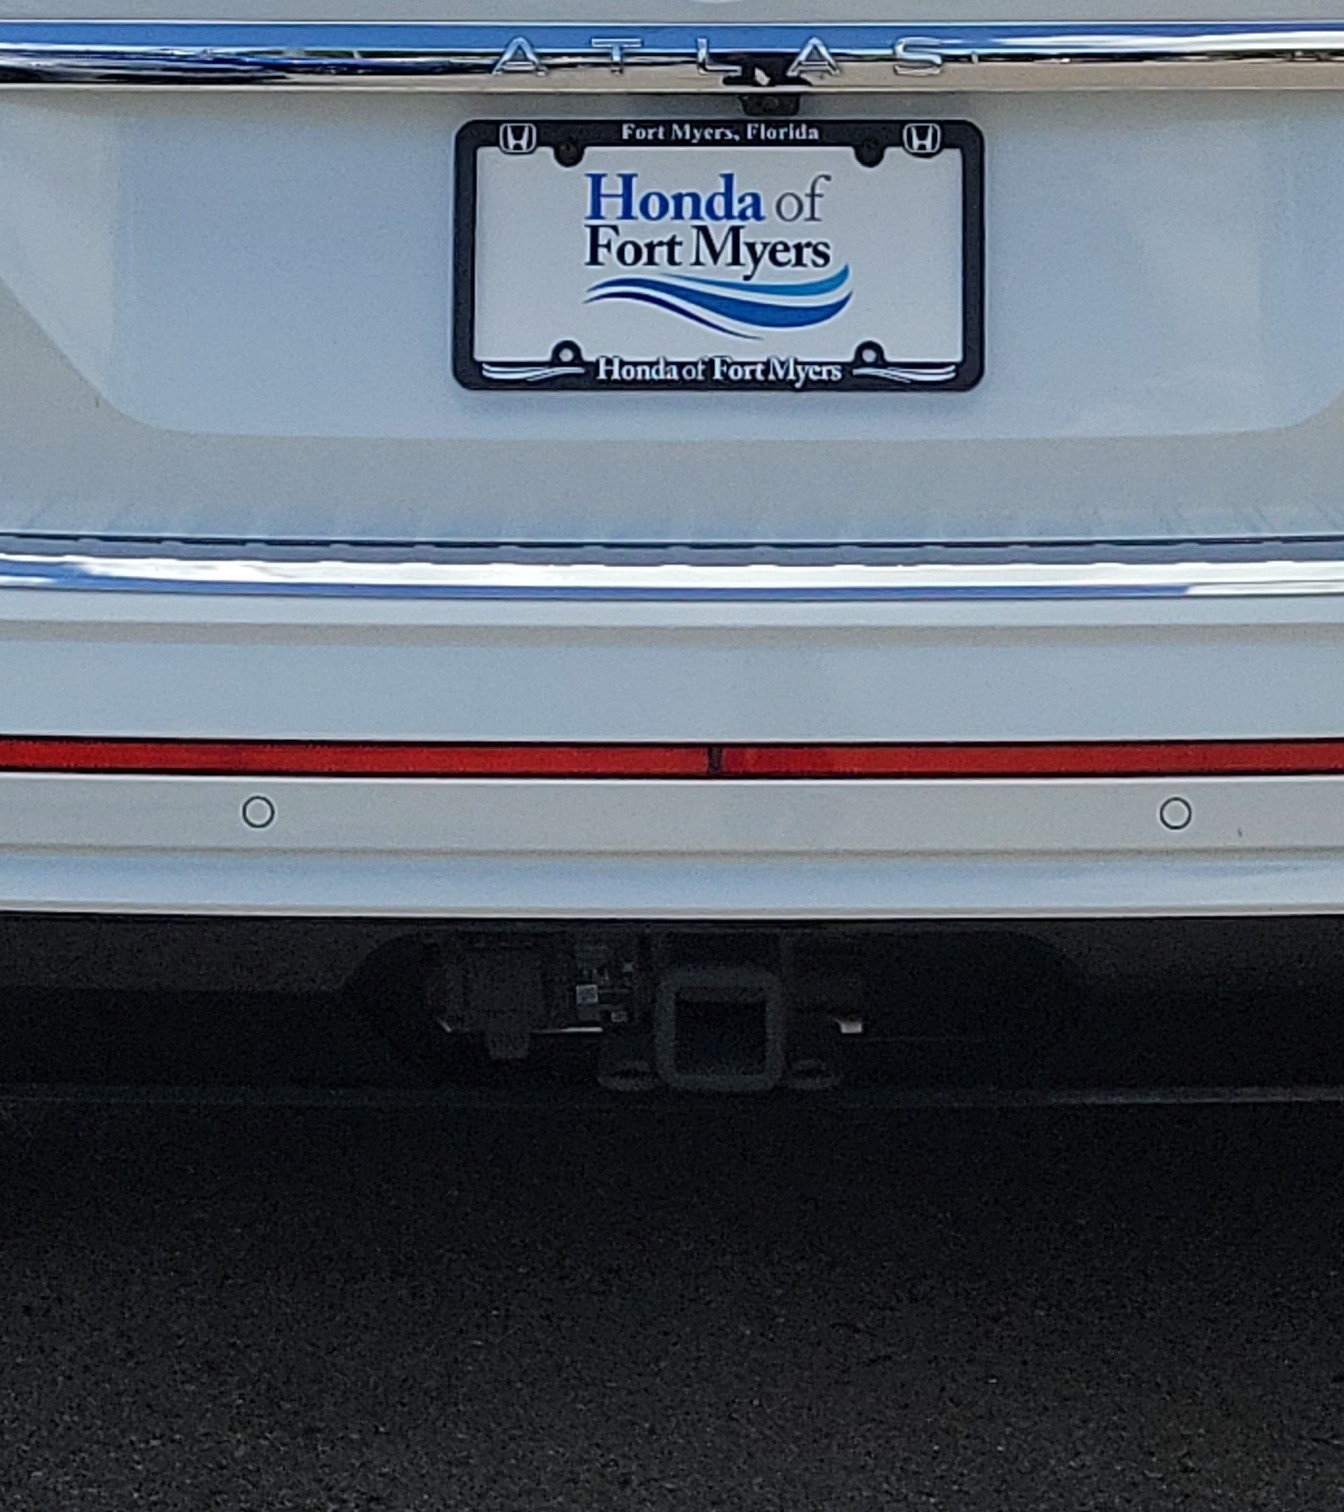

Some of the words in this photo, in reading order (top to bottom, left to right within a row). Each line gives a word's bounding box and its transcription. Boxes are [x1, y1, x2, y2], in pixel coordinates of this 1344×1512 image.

[491, 36, 943, 76] ATLAS
[621, 123, 665, 140] Fort
[671, 123, 741, 144] Myers,
[746, 123, 820, 140] Florida
[584, 173, 765, 223] Honda
[774, 173, 832, 223] of
[584, 225, 683, 268] Fort
[691, 225, 831, 281] Myers
[596, 356, 679, 381] Honda
[681, 356, 707, 381] of
[712, 356, 766, 381] Fort
[768, 356, 843, 389] Myers
